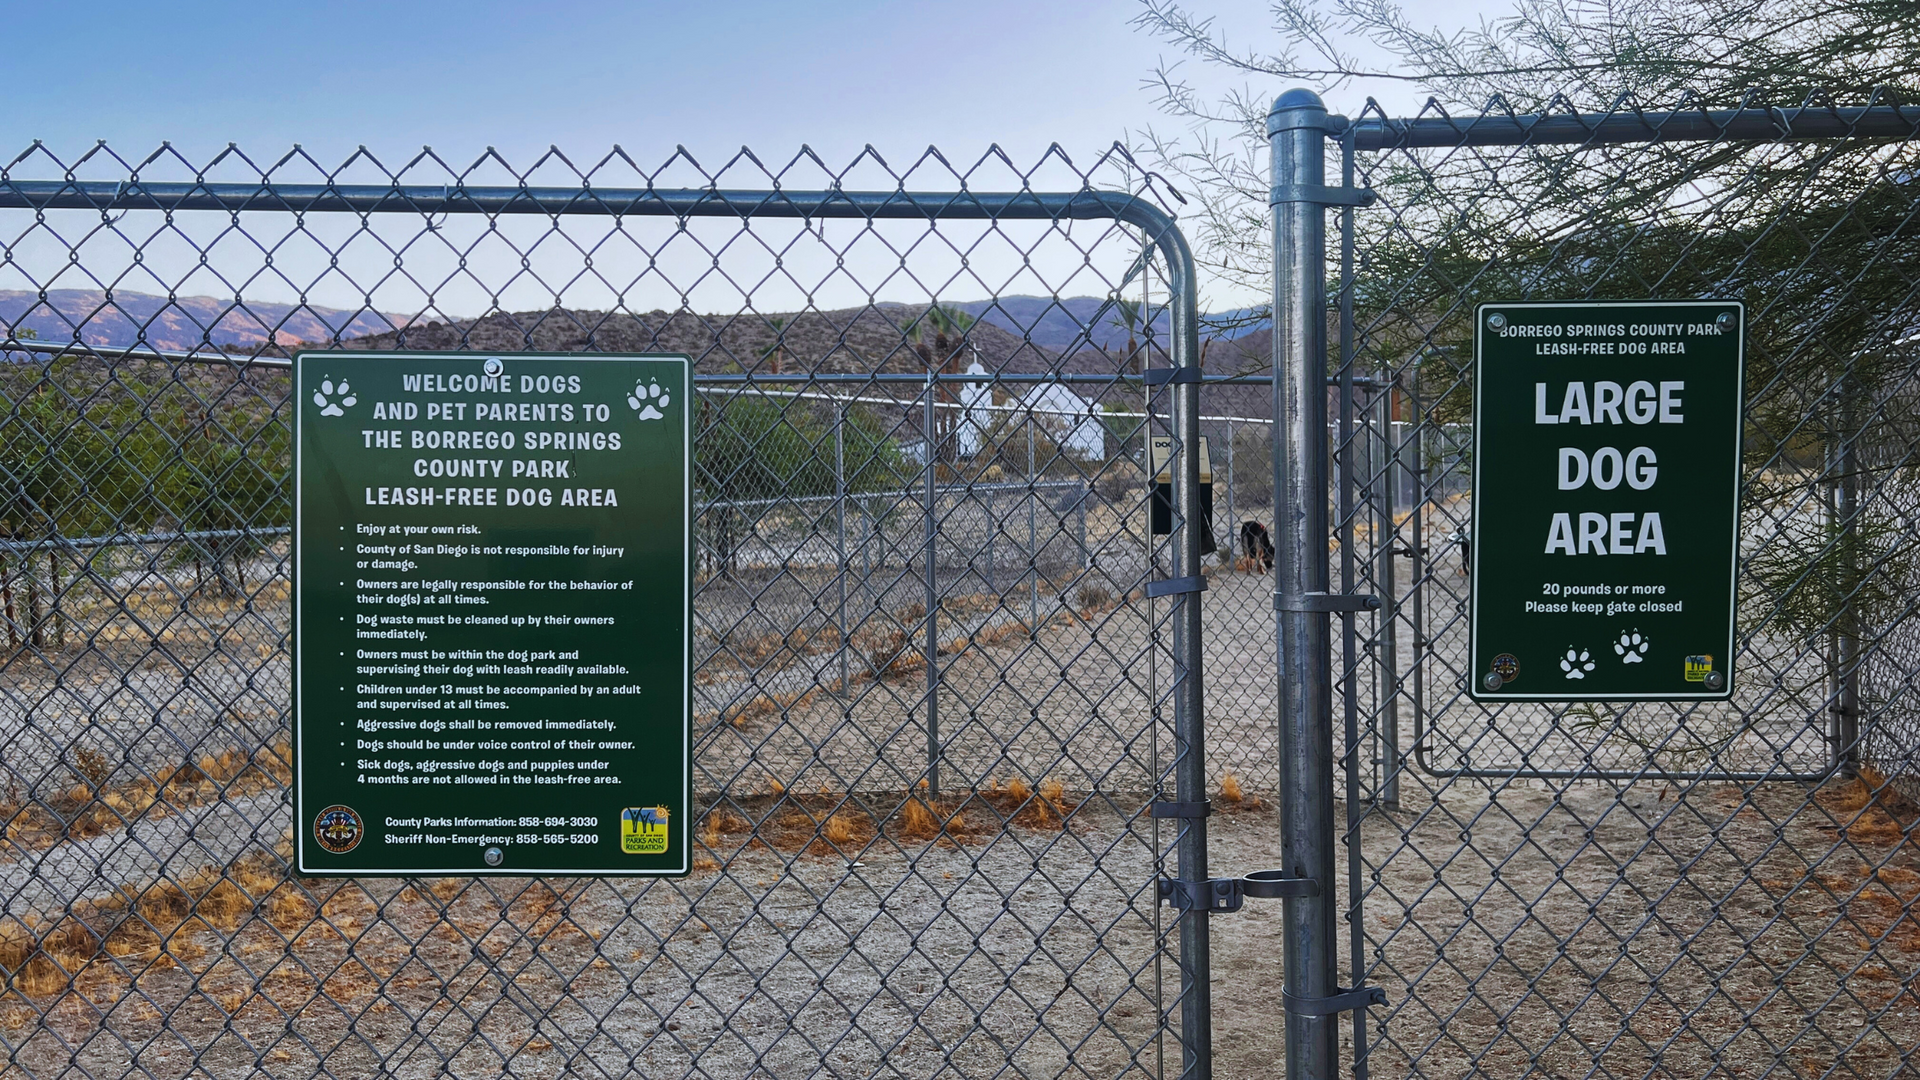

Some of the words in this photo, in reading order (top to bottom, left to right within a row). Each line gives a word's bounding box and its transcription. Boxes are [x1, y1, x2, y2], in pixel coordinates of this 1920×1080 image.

[1500, 325, 1562, 337] BORREGO
[1567, 324, 1625, 337] SPRINGS
[1630, 324, 1683, 336] COUNTY
[1688, 324, 1722, 336] PARK
[1536, 343, 1614, 355] LEASH-FREE
[1619, 342, 1646, 354] DOG
[1651, 342, 1685, 354] AREA
[403, 374, 511, 393] WELCOME
[521, 375, 581, 393] DOGS
[1535, 380, 1684, 425] LARGE
[373, 402, 418, 420] AND
[427, 403, 467, 420] PET
[476, 403, 574, 422] PARENTS
[582, 404, 610, 422] TO
[362, 430, 402, 448] THE
[412, 430, 515, 449] BORREGO
[524, 432, 621, 450] SPRINGS
[414, 459, 503, 478] COUNTY
[512, 460, 569, 478] PARK
[1558, 446, 1658, 490] DOG
[366, 487, 497, 506] LEASH-FREE
[507, 488, 552, 506] DOG
[561, 489, 618, 507] AREA
[357, 523, 386, 536] Enjoy
[389, 525, 401, 533] at
[403, 526, 429, 536] your
[431, 526, 454, 534] own
[457, 524, 481, 534] risk.
[1544, 512, 1667, 556] AREA
[357, 544, 396, 556] County
[399, 544, 411, 554] of
[414, 544, 434, 554] San
[437, 544, 468, 557] Diego
[471, 544, 481, 555] is
[483, 545, 502, 554] not
[505, 545, 570, 557] responsible
[573, 545, 590, 555] for
[593, 545, 624, 558] injury
[371, 559, 418, 572] damage.
[357, 579, 398, 589] Owners
[400, 581, 419, 589] are
[422, 579, 458, 592] legally
[461, 580, 526, 592] responsible
[528, 580, 546, 589] for
[548, 580, 567, 590] the
[570, 580, 618, 590] behavior
[621, 580, 633, 590] of
[1543, 583, 1560, 595] 20
[1564, 583, 1611, 598] pounds
[1615, 586, 1629, 594] or
[1632, 585, 1665, 594] more
[356, 594, 384, 604] their
[386, 593, 420, 607] dog(s)
[423, 595, 435, 604] at
[438, 594, 451, 604] all
[454, 594, 489, 604] times.
[1525, 601, 1568, 612] Please
[1572, 601, 1603, 615] keep
[1607, 601, 1636, 616] gate
[1639, 600, 1682, 612] closed
[357, 614, 378, 627] Dog
[380, 615, 414, 624] waste
[417, 615, 445, 624] must
[448, 615, 462, 624] be
[465, 615, 508, 624] cleaned
[511, 617, 525, 627] up
[528, 615, 541, 627] by
[544, 615, 571, 625] their
[574, 617, 614, 625] owners
[357, 629, 427, 641] immediately.
[357, 649, 398, 659] Owners
[401, 650, 429, 659] must
[432, 650, 446, 659] be
[448, 649, 483, 659] within
[486, 650, 504, 660] the
[507, 650, 528, 663] dog
[531, 650, 556, 662] park
[558, 650, 579, 660] and
[357, 664, 421, 677] supervising
[423, 664, 450, 674] their
[453, 664, 474, 677] dog
[476, 664, 500, 674] with
[503, 664, 533, 674] leash
[536, 664, 574, 677] readily
[577, 664, 629, 674] available.
[357, 684, 402, 694] Children
[405, 685, 437, 694] under
[440, 684, 453, 694] 13
[456, 685, 483, 694] must
[486, 685, 500, 694] be
[503, 684, 577, 697] accompanied
[580, 685, 593, 697] by
[612, 685, 641, 694] adult
[357, 699, 377, 709] and
[380, 699, 441, 711] supervised
[444, 700, 456, 709] at
[458, 699, 471, 709] all
[474, 699, 509, 709] times.
[357, 719, 417, 732] Aggressive
[419, 719, 446, 732] dogs
[449, 719, 474, 729] shall
[478, 720, 491, 729] be
[494, 720, 542, 729] removed
[545, 719, 616, 732] immediately.
[357, 739, 384, 752] Dogs
[387, 740, 423, 749] should
[426, 740, 440, 749] be
[443, 740, 475, 749] under
[478, 739, 508, 749] voice
[510, 740, 551, 749] control
[554, 740, 566, 749] of
[568, 739, 596, 749] their
[357, 759, 381, 769] Sick
[384, 760, 413, 772] dogs,
[416, 759, 475, 773] aggressive
[478, 760, 505, 773] dogs
[507, 760, 527, 769] and
[531, 759, 574, 772] puppies
[577, 760, 609, 769] under
[357, 774, 365, 783] 4
[368, 774, 409, 784] months
[412, 776, 430, 784] are
[433, 775, 451, 784] not
[454, 774, 497, 784] allowed
[500, 774, 510, 784] in
[513, 775, 531, 784] the
[534, 774, 591, 784] leash-free
[594, 776, 621, 784] area.
[385, 817, 422, 829] County
[424, 817, 452, 827] Parks
[454, 817, 517, 826] Information:
[519, 817, 598, 827] 858-694-3030
[385, 834, 423, 844] Sheriff
[425, 834, 513, 846] Non-Emergency:
[516, 834, 598, 844] 858-565-5200
